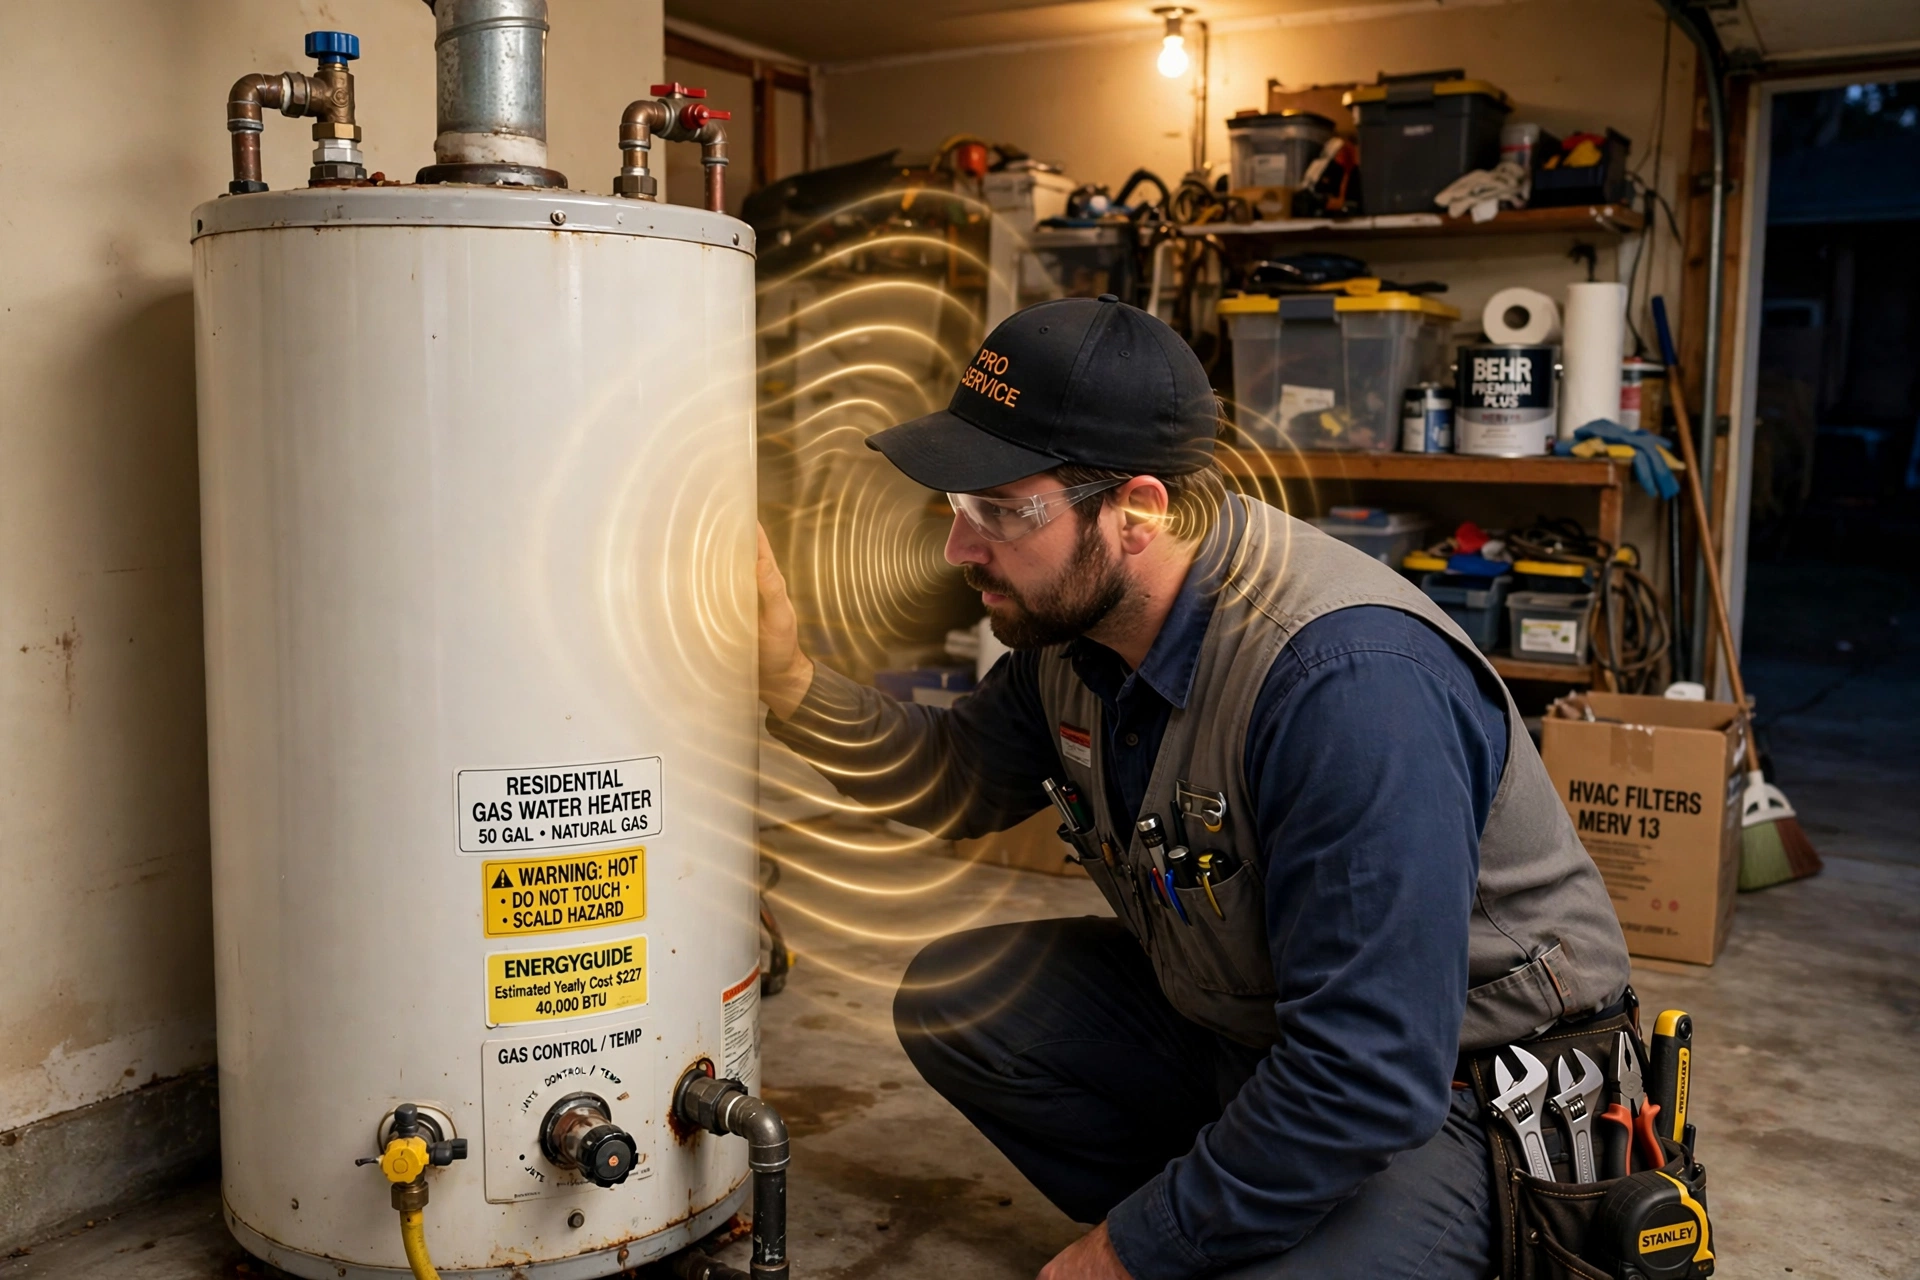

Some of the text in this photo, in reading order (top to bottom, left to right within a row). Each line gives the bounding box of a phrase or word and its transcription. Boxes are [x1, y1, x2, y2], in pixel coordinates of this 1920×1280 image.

[976, 348, 1008, 375] PRO
[1473, 357, 1532, 382] BEHR
[962, 366, 1020, 408] SERVICE
[1472, 382, 1532, 396] PREMIUM
[1484, 396, 1519, 408] PLUS
[506, 769, 623, 796] RESIDENTIAL
[472, 789, 652, 822] GAS WATER HEATER
[1569, 780, 1702, 815] HVAC FILTERS
[478, 814, 648, 844] 50 GAL NATURAL GAS
[1578, 810, 1660, 840] MERV 13
[518, 856, 638, 886] WARNING: HOT
[512, 881, 620, 908] DO NOT TOUCH
[513, 900, 624, 928] SCALD HAZARD
[504, 946, 632, 978] ENERGYGUIDE
[495, 968, 642, 999] Estimated Yearly Cost $227
[536, 992, 606, 1016] 40,000 BTU
[498, 1047, 528, 1064] GAS
[533, 1038, 597, 1060] CONTROL
[609, 1028, 642, 1049] TEMP
[1642, 1226, 1694, 1248] STANLEY
